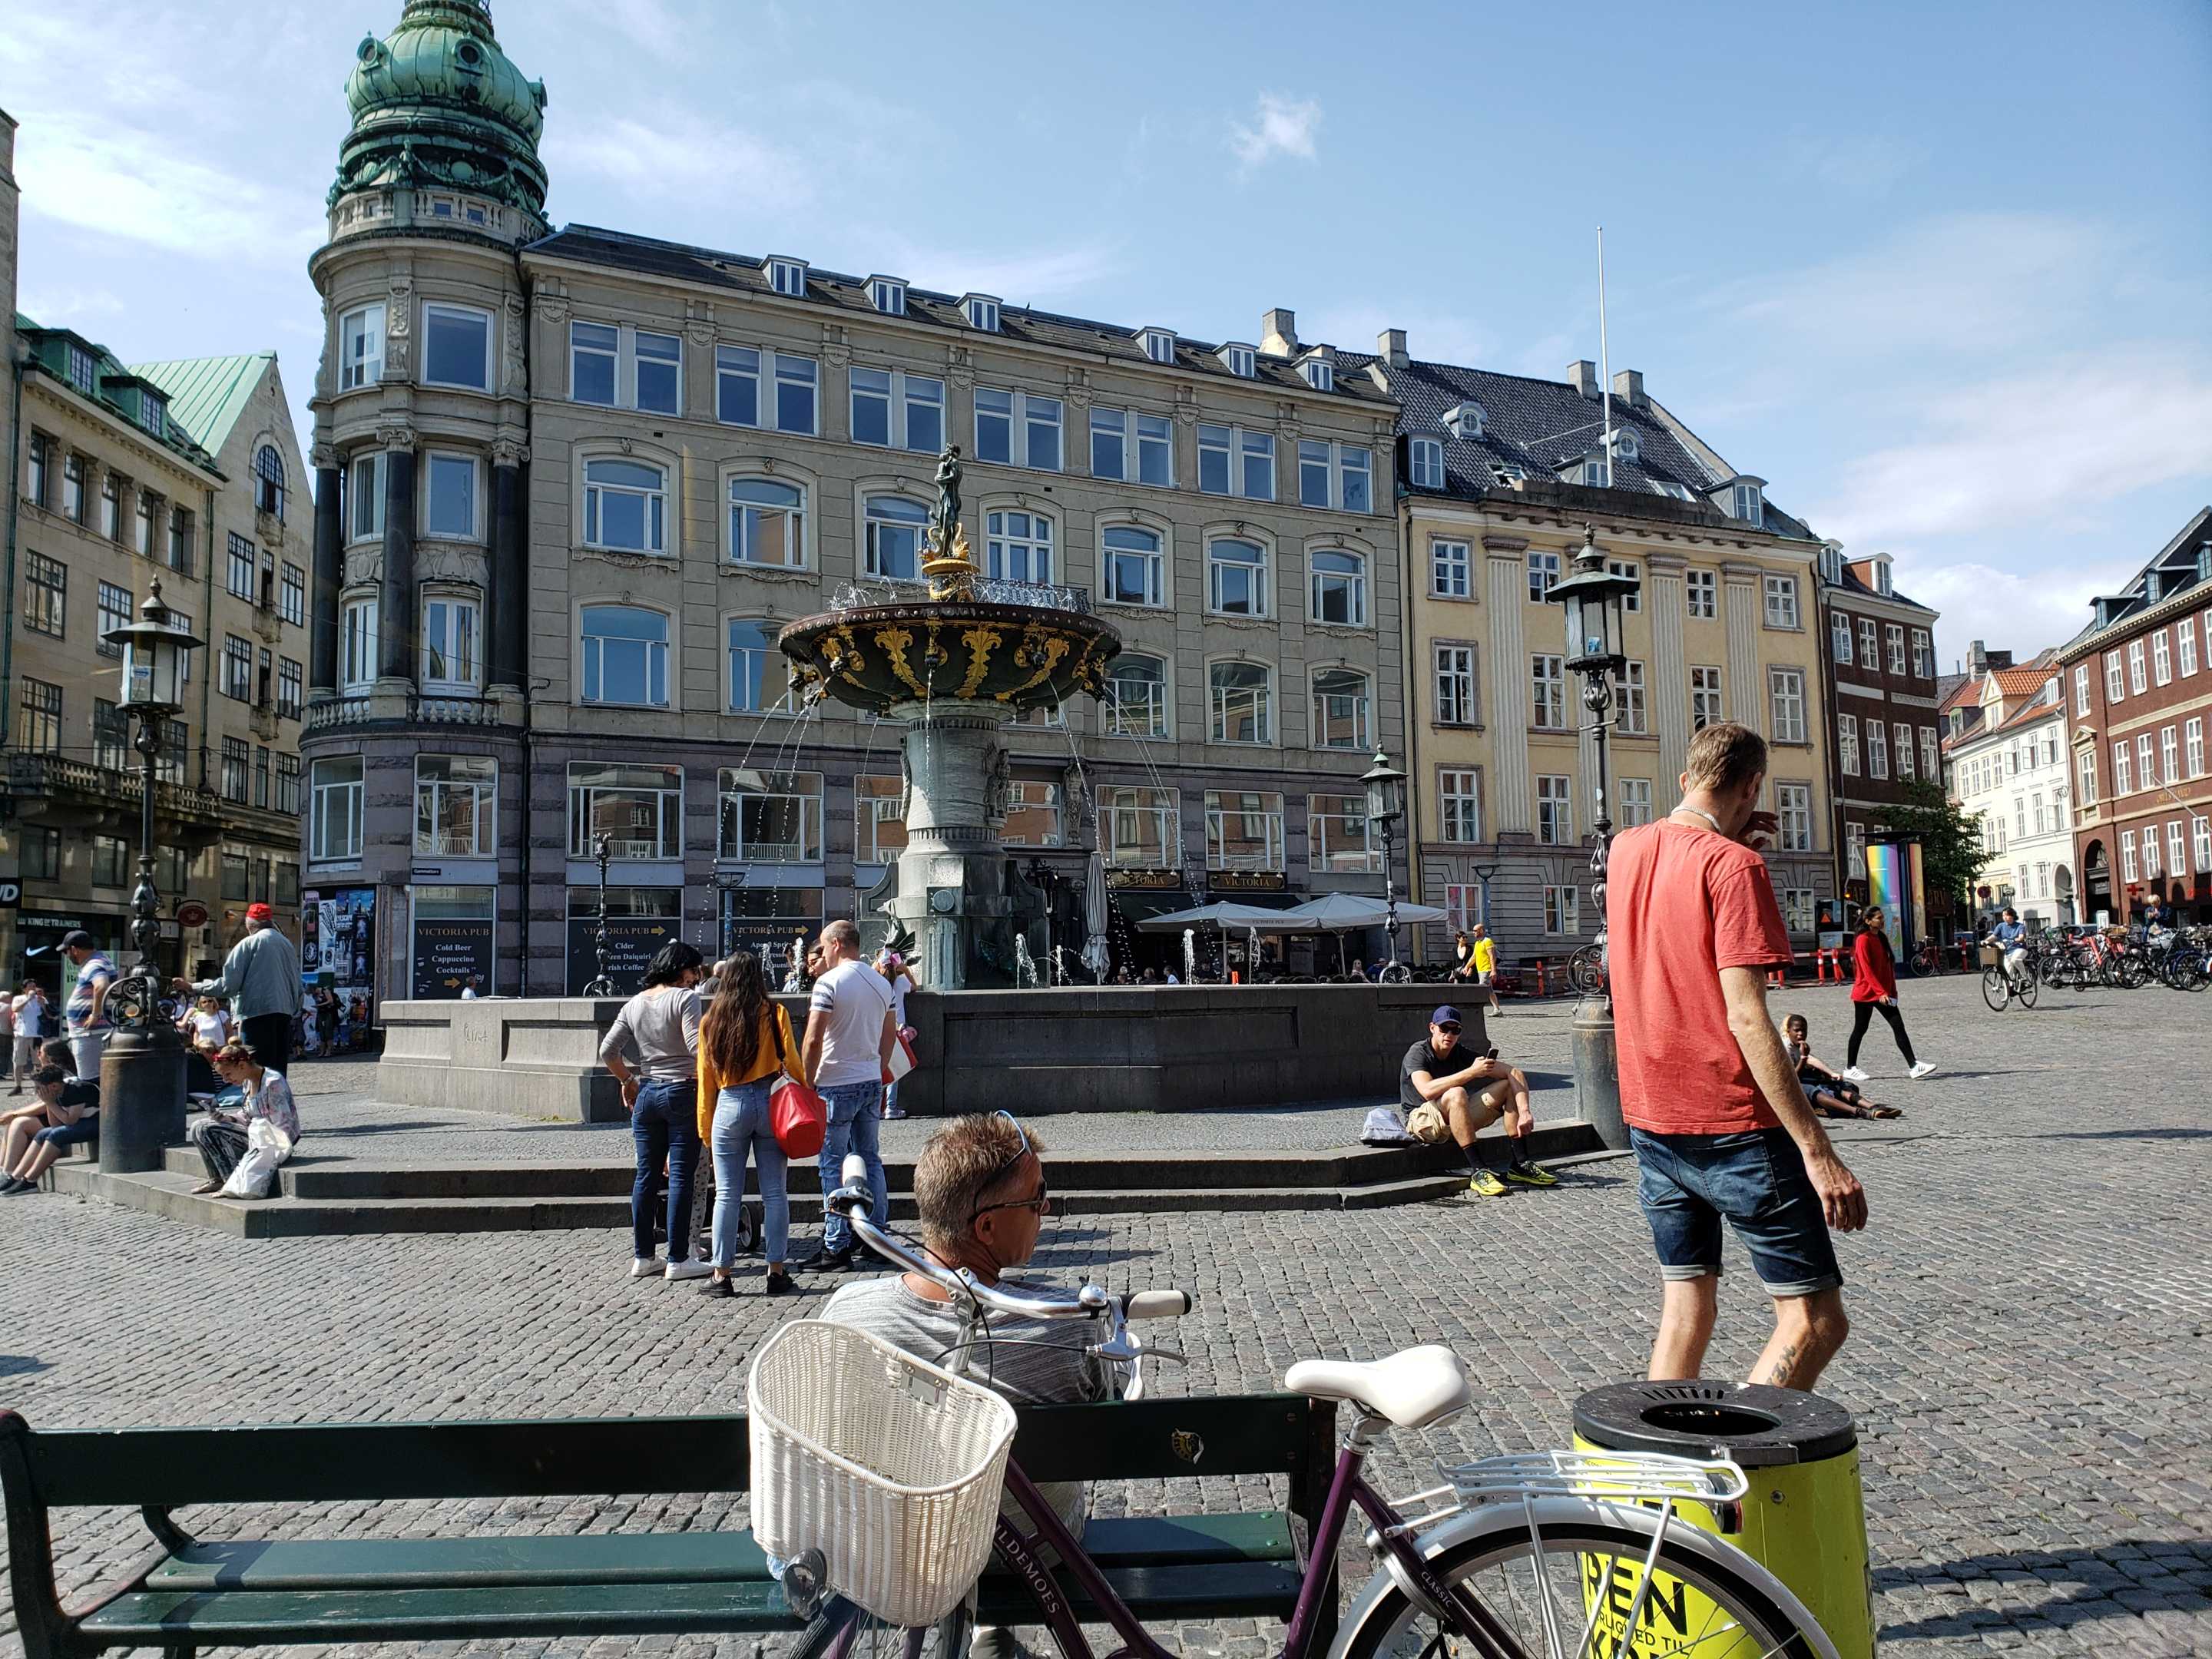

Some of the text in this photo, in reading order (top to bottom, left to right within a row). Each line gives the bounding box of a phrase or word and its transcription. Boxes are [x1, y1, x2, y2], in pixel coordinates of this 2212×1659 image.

[1118, 875, 1164, 885] VICTORIA
[1224, 877, 1270, 886] VICTORIA
[28, 917, 43, 926] KING
[51, 919, 81, 928] TRAINERS
[418, 928, 469, 936] VICTORIA
[432, 955, 475, 964] Cappuccino
[1421, 1571, 1452, 1608] CLASSIC
